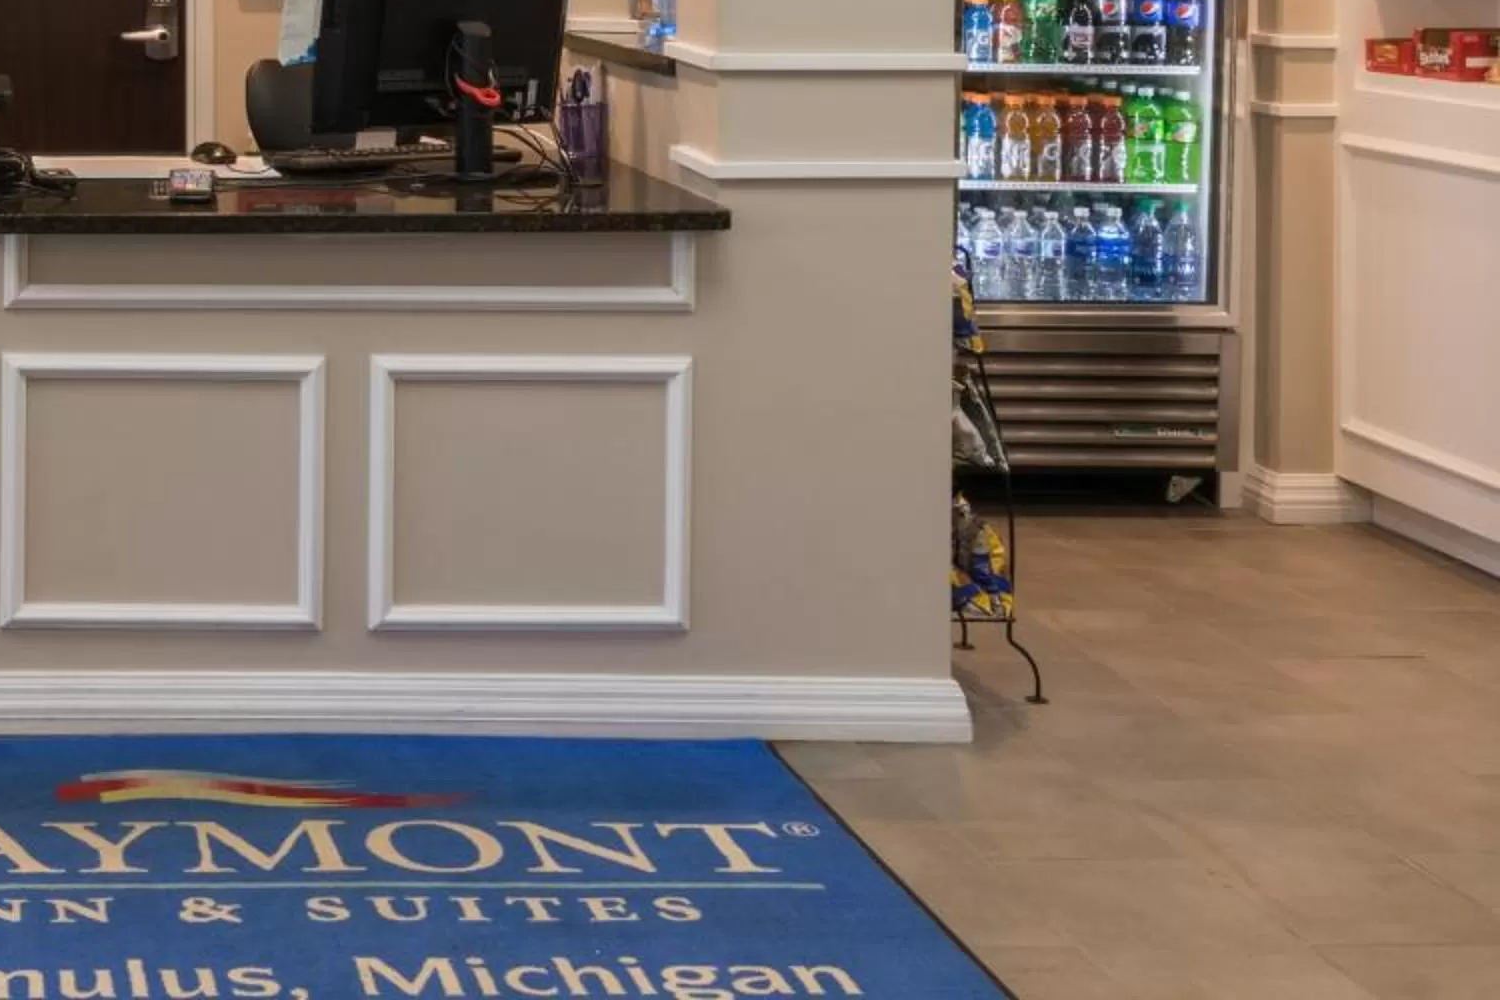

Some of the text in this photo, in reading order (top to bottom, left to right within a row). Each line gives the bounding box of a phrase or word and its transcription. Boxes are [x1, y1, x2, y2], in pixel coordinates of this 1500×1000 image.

[178, 895, 243, 924] &
[305, 896, 703, 922] SUITES
[352, 955, 866, 1000] Michigan
